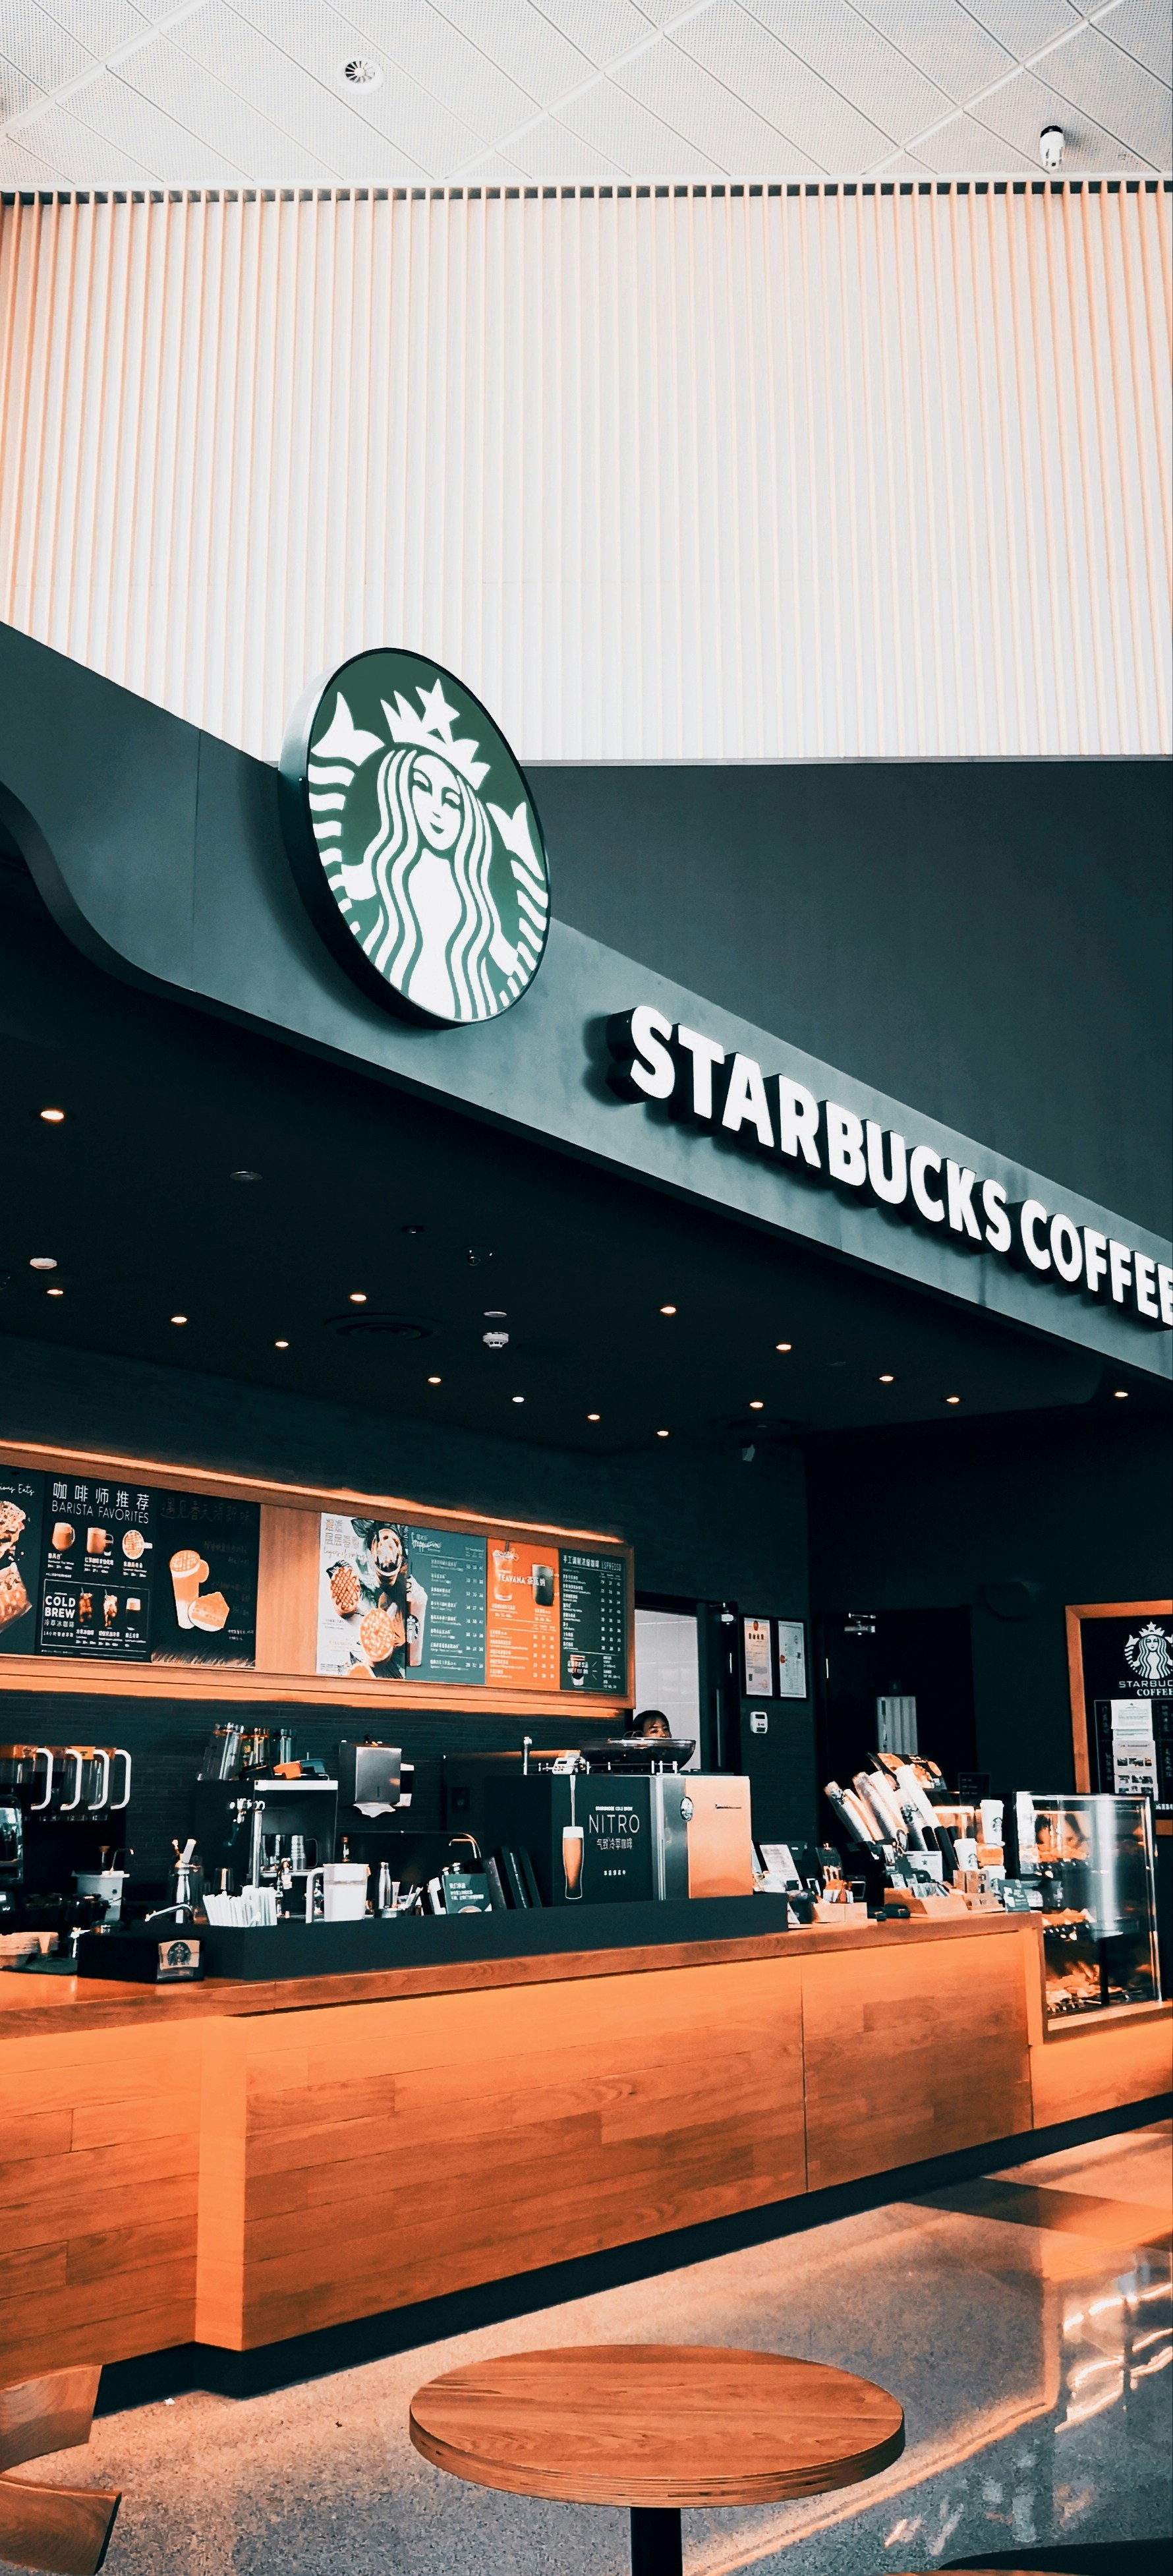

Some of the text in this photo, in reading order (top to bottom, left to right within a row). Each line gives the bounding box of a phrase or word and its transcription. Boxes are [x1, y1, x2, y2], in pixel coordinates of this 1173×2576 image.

[631, 1005, 1173, 1326] STARBUCKS COFFEE
[18, 1484, 35, 1496] Eats
[53, 1482, 150, 1511] 咖啡师推荐
[52, 1500, 149, 1524] BARISTA FAVORITES
[601, 1560, 621, 1571] ESPRESSO
[45, 1596, 76, 1607] COLD
[45, 1607, 76, 1619] BREW
[589, 1814, 640, 1833] NITRO
